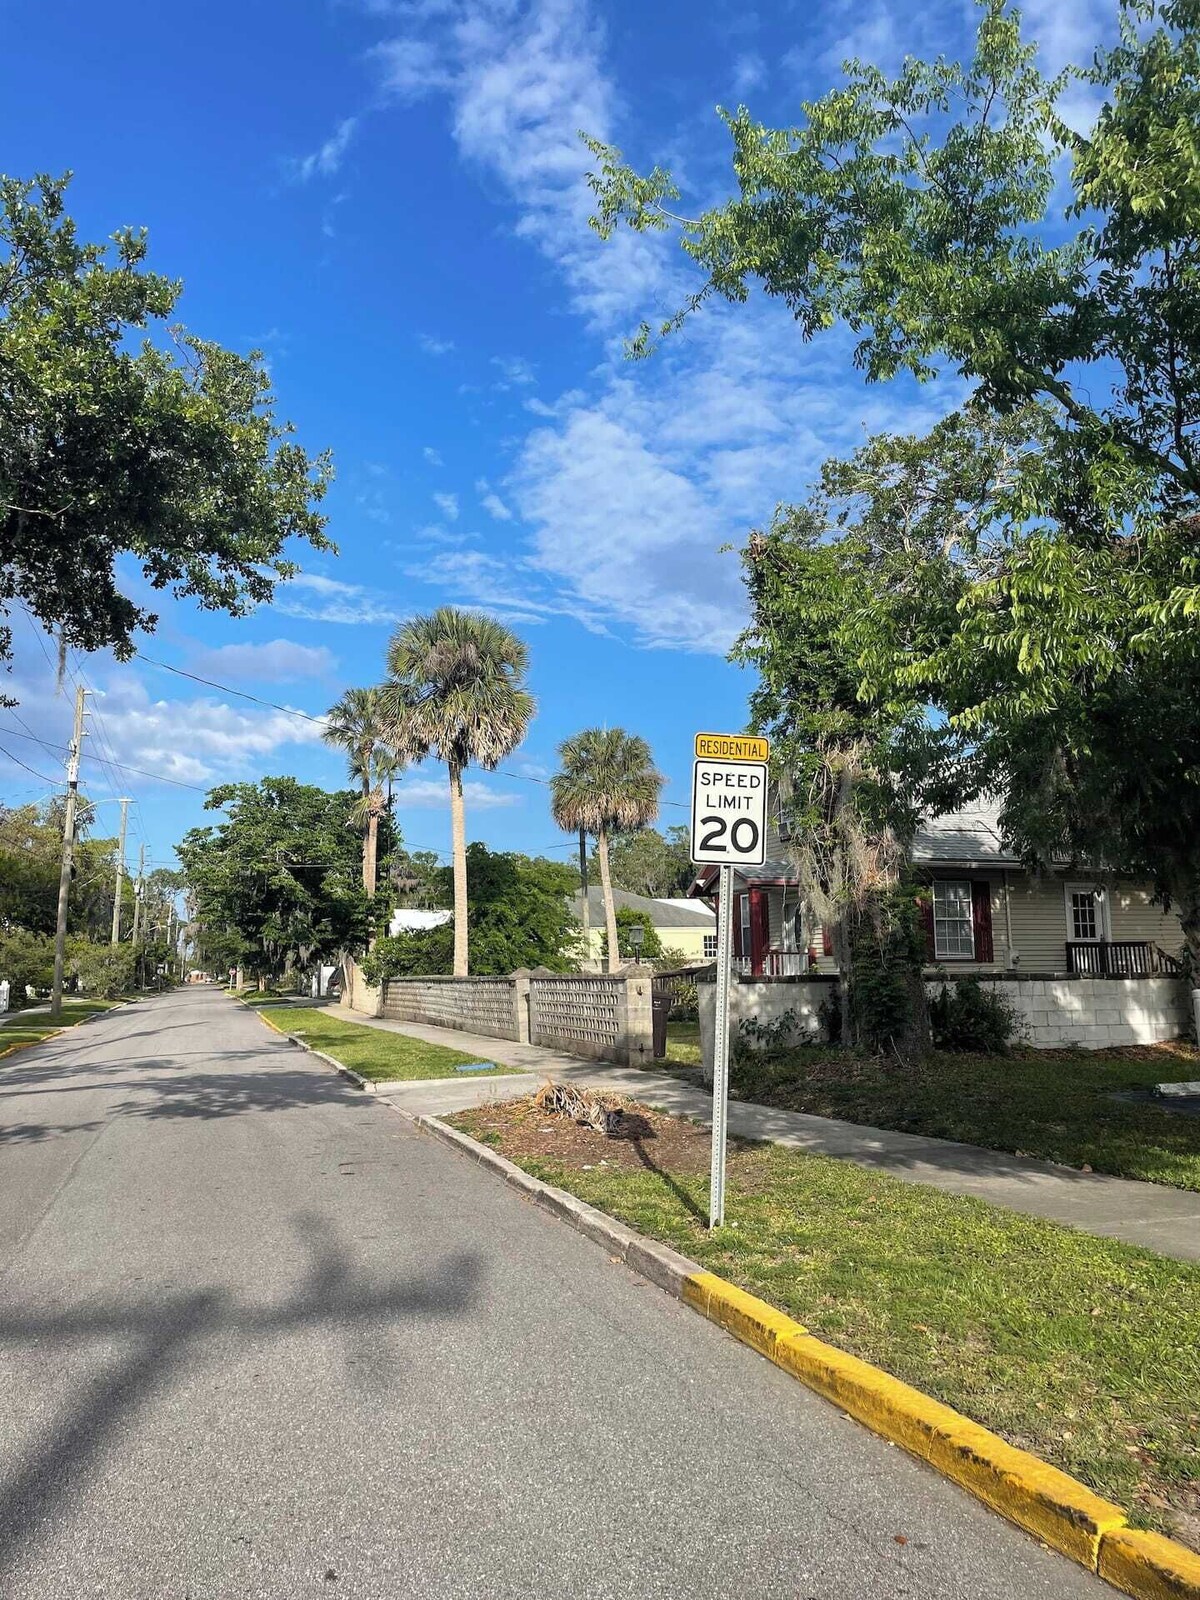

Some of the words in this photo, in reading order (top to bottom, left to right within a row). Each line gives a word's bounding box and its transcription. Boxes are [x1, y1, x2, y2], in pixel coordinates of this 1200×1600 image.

[700, 739, 764, 757] RESIDENTIAL
[700, 772, 761, 788] SPEED
[706, 794, 753, 810] LIMIT
[699, 815, 759, 853] 20
